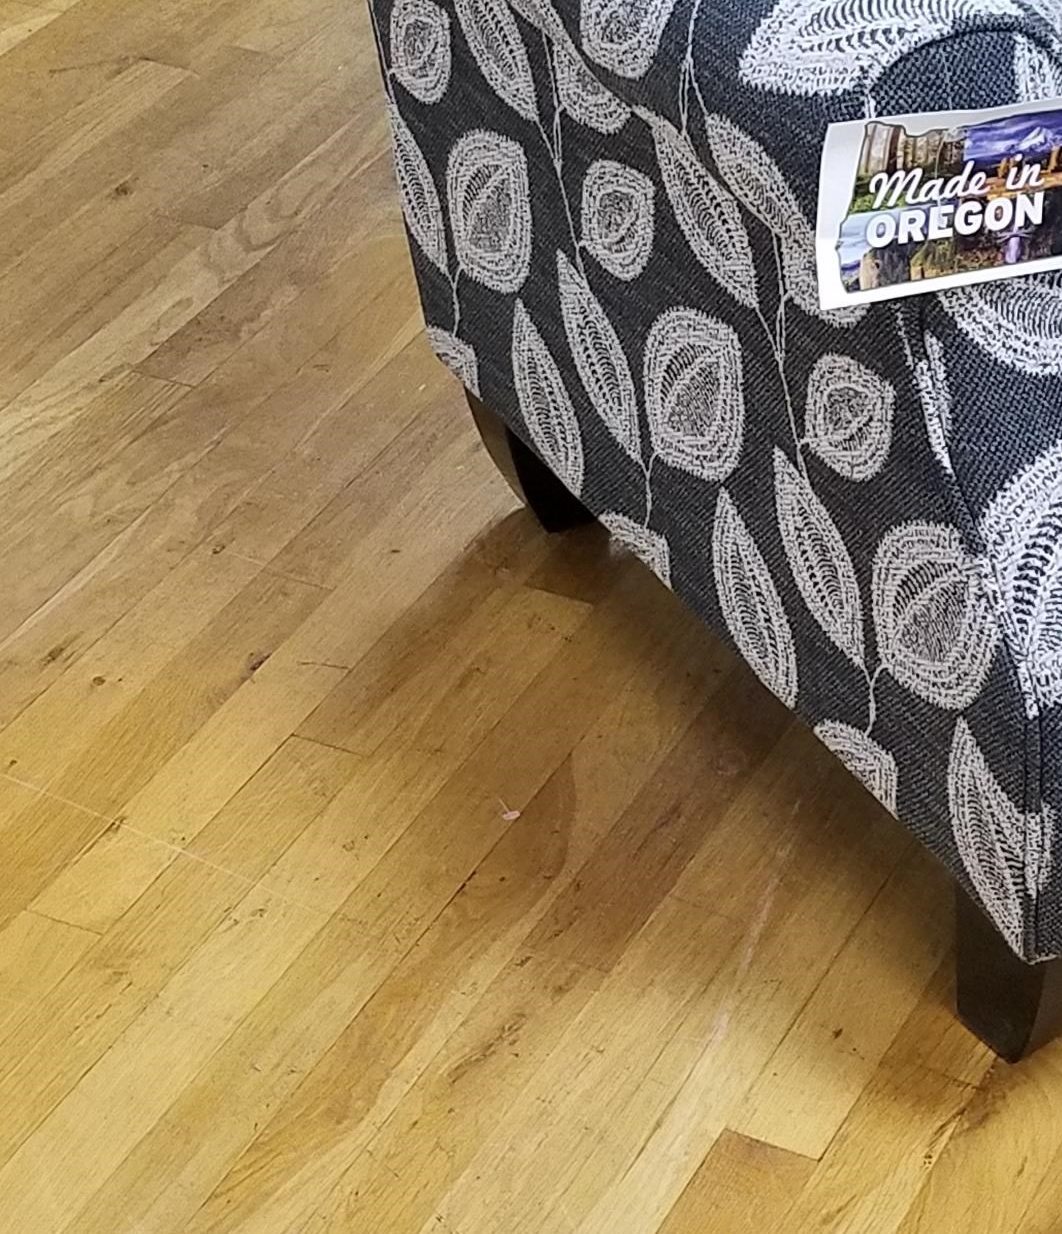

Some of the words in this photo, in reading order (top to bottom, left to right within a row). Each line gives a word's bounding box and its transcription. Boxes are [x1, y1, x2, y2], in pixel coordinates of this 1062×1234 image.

[868, 160, 990, 209] Made
[1006, 153, 1044, 190] in
[866, 191, 1045, 248] OREGON
